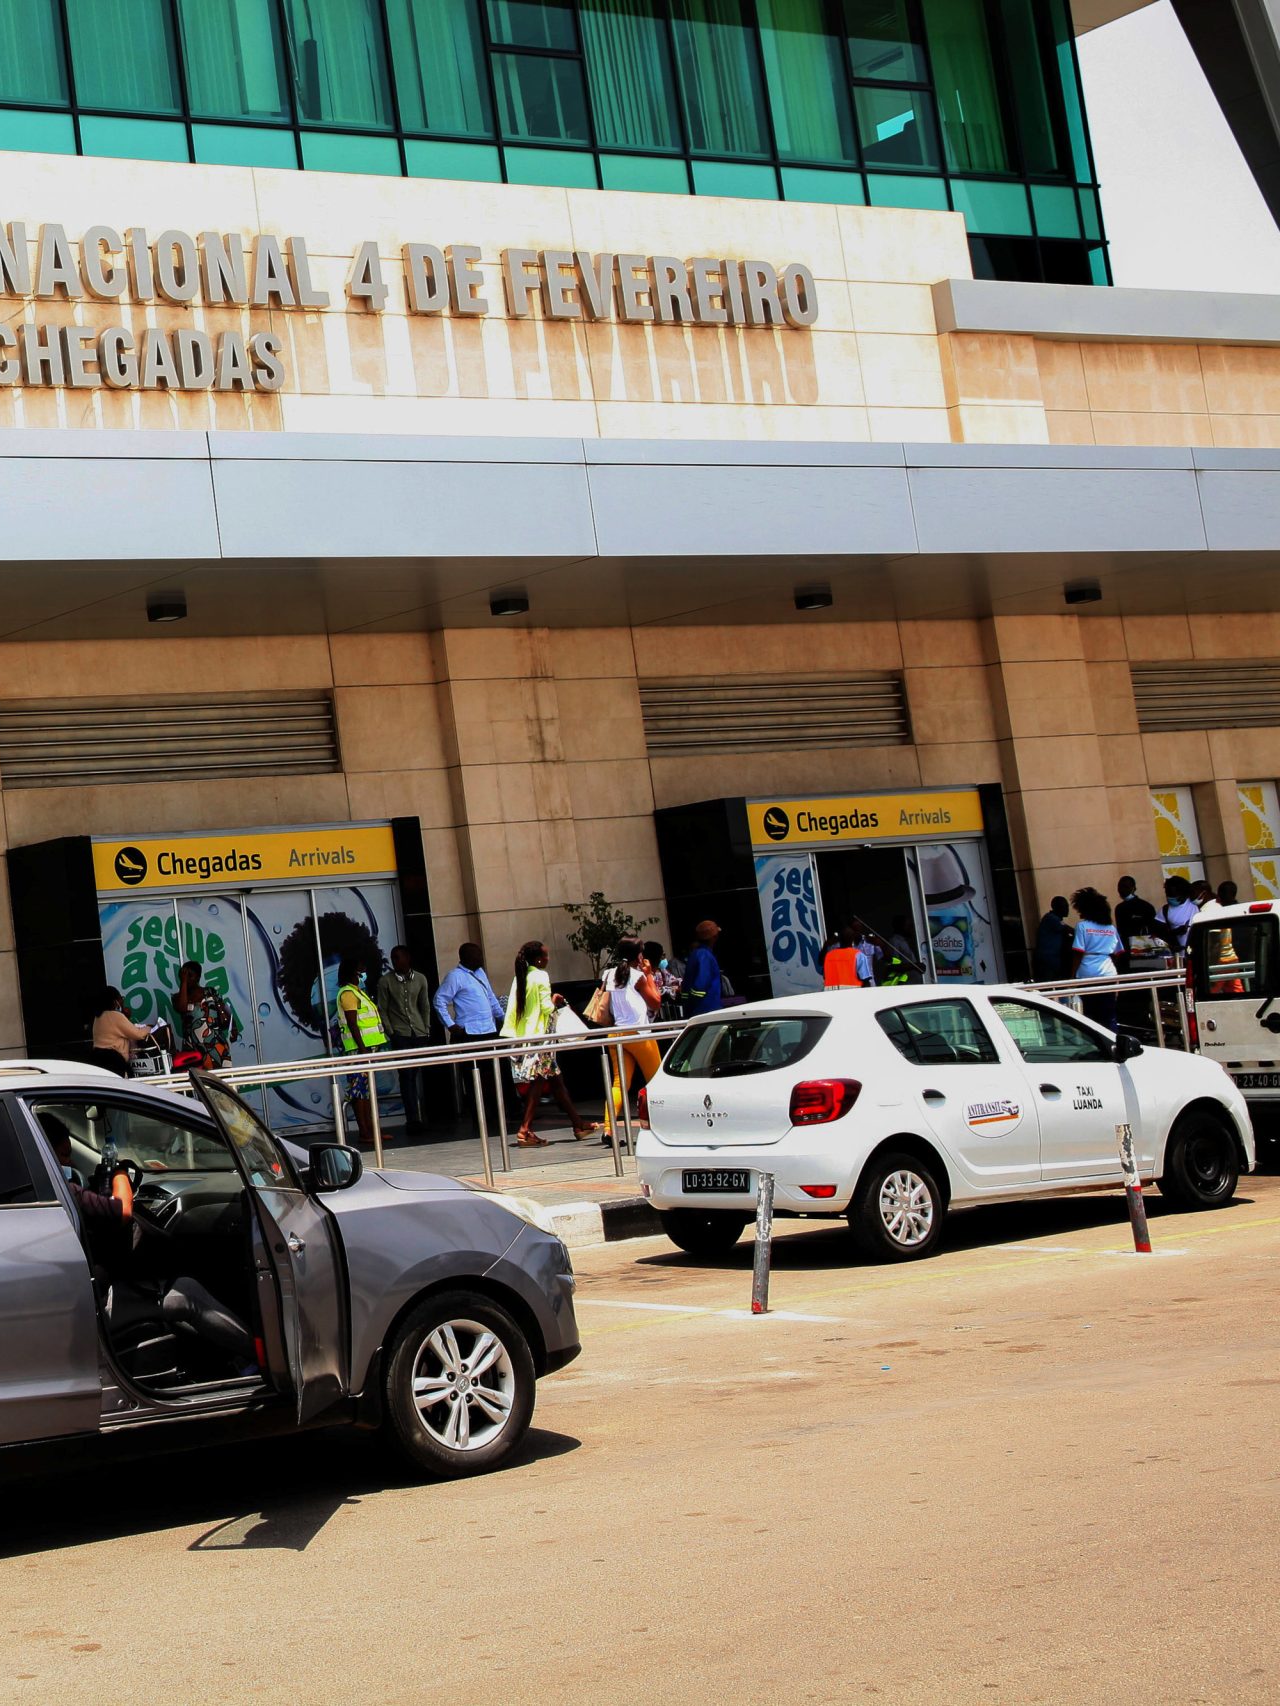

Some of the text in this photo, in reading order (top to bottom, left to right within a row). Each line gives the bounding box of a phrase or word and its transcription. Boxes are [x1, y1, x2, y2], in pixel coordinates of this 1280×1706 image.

[346, 241, 390, 315] 4
[402, 243, 490, 317] DE
[501, 248, 819, 330] FEVEREIRO
[796, 808, 951, 835] Chegadas Arrivals
[157, 846, 356, 879] Chegadas Arrivals
[126, 915, 226, 964] segue
[120, 949, 230, 996] a ta
[1073, 1098, 1103, 1110] LUANDA
[1076, 1085, 1094, 1097] TAXI
